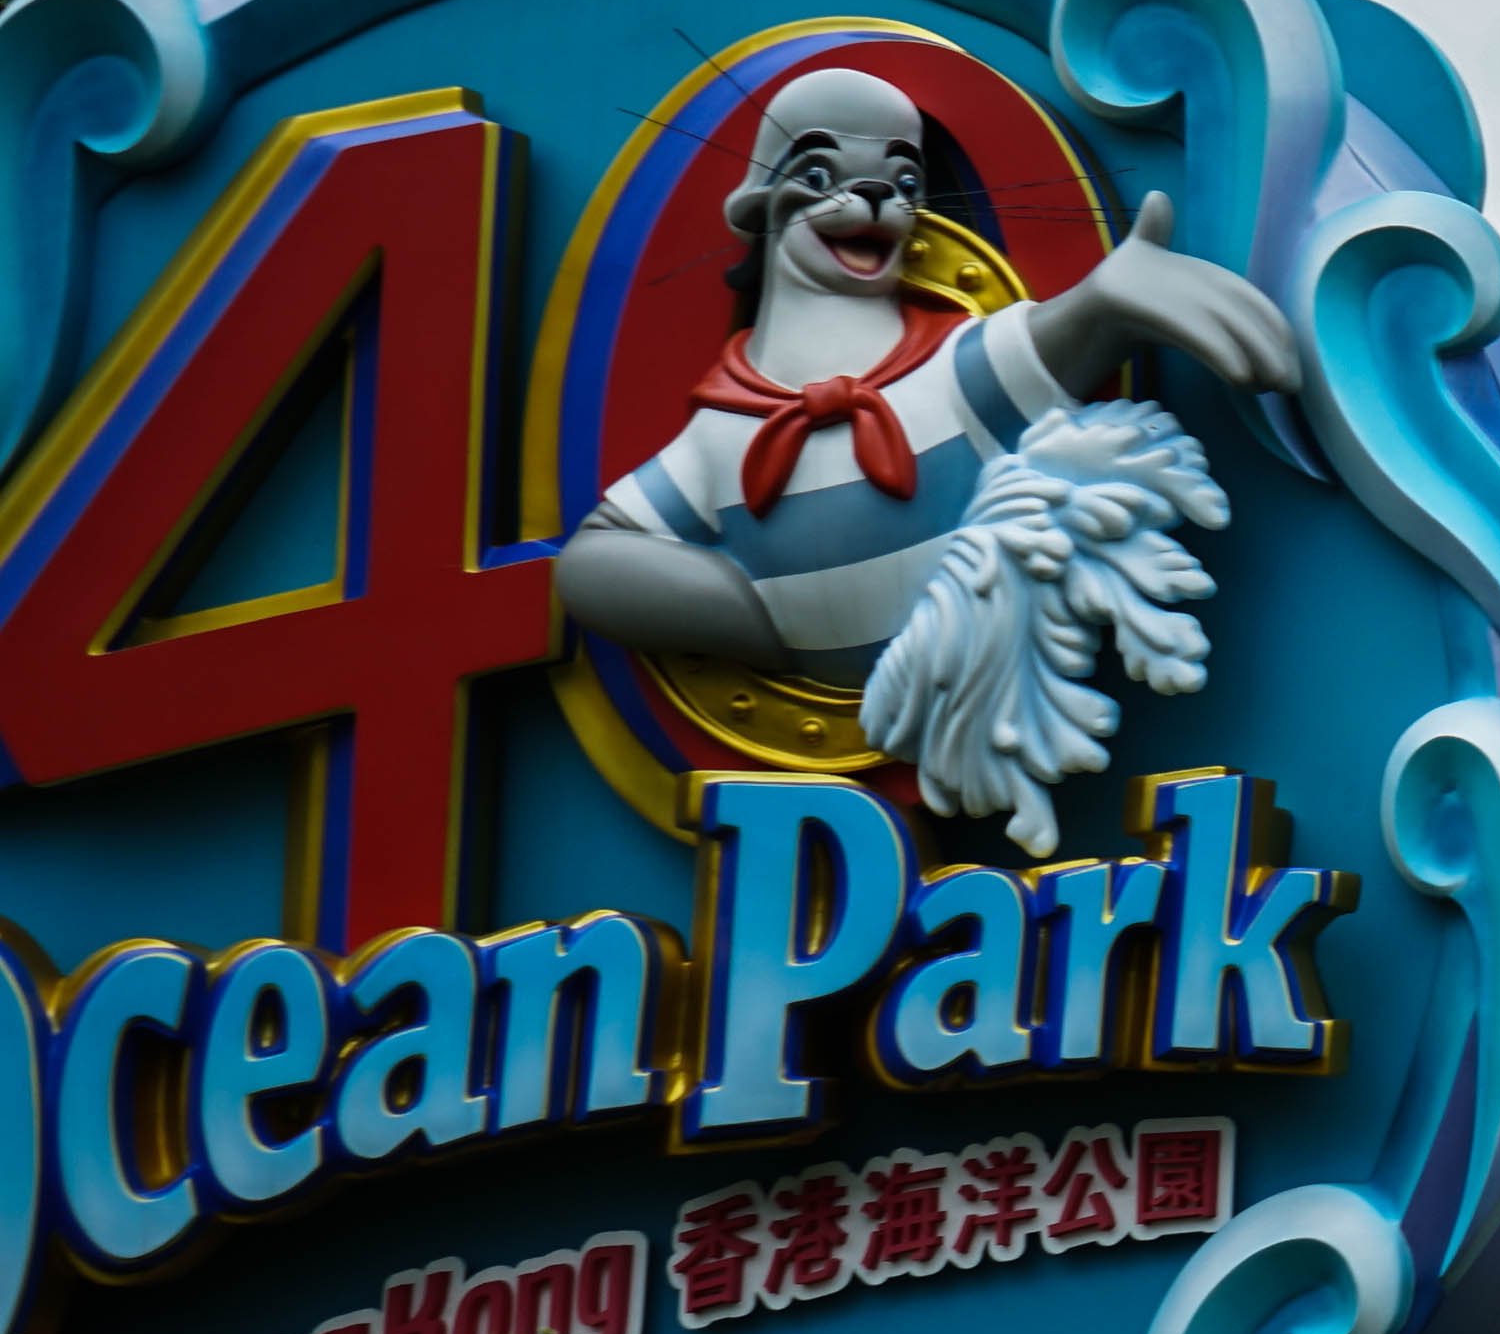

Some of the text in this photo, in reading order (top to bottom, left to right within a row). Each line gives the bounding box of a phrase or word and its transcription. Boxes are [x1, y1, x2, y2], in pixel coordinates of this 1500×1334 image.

[680, 769, 1350, 1147] Park
[670, 1125, 1228, 1319] 香港海洋公園
